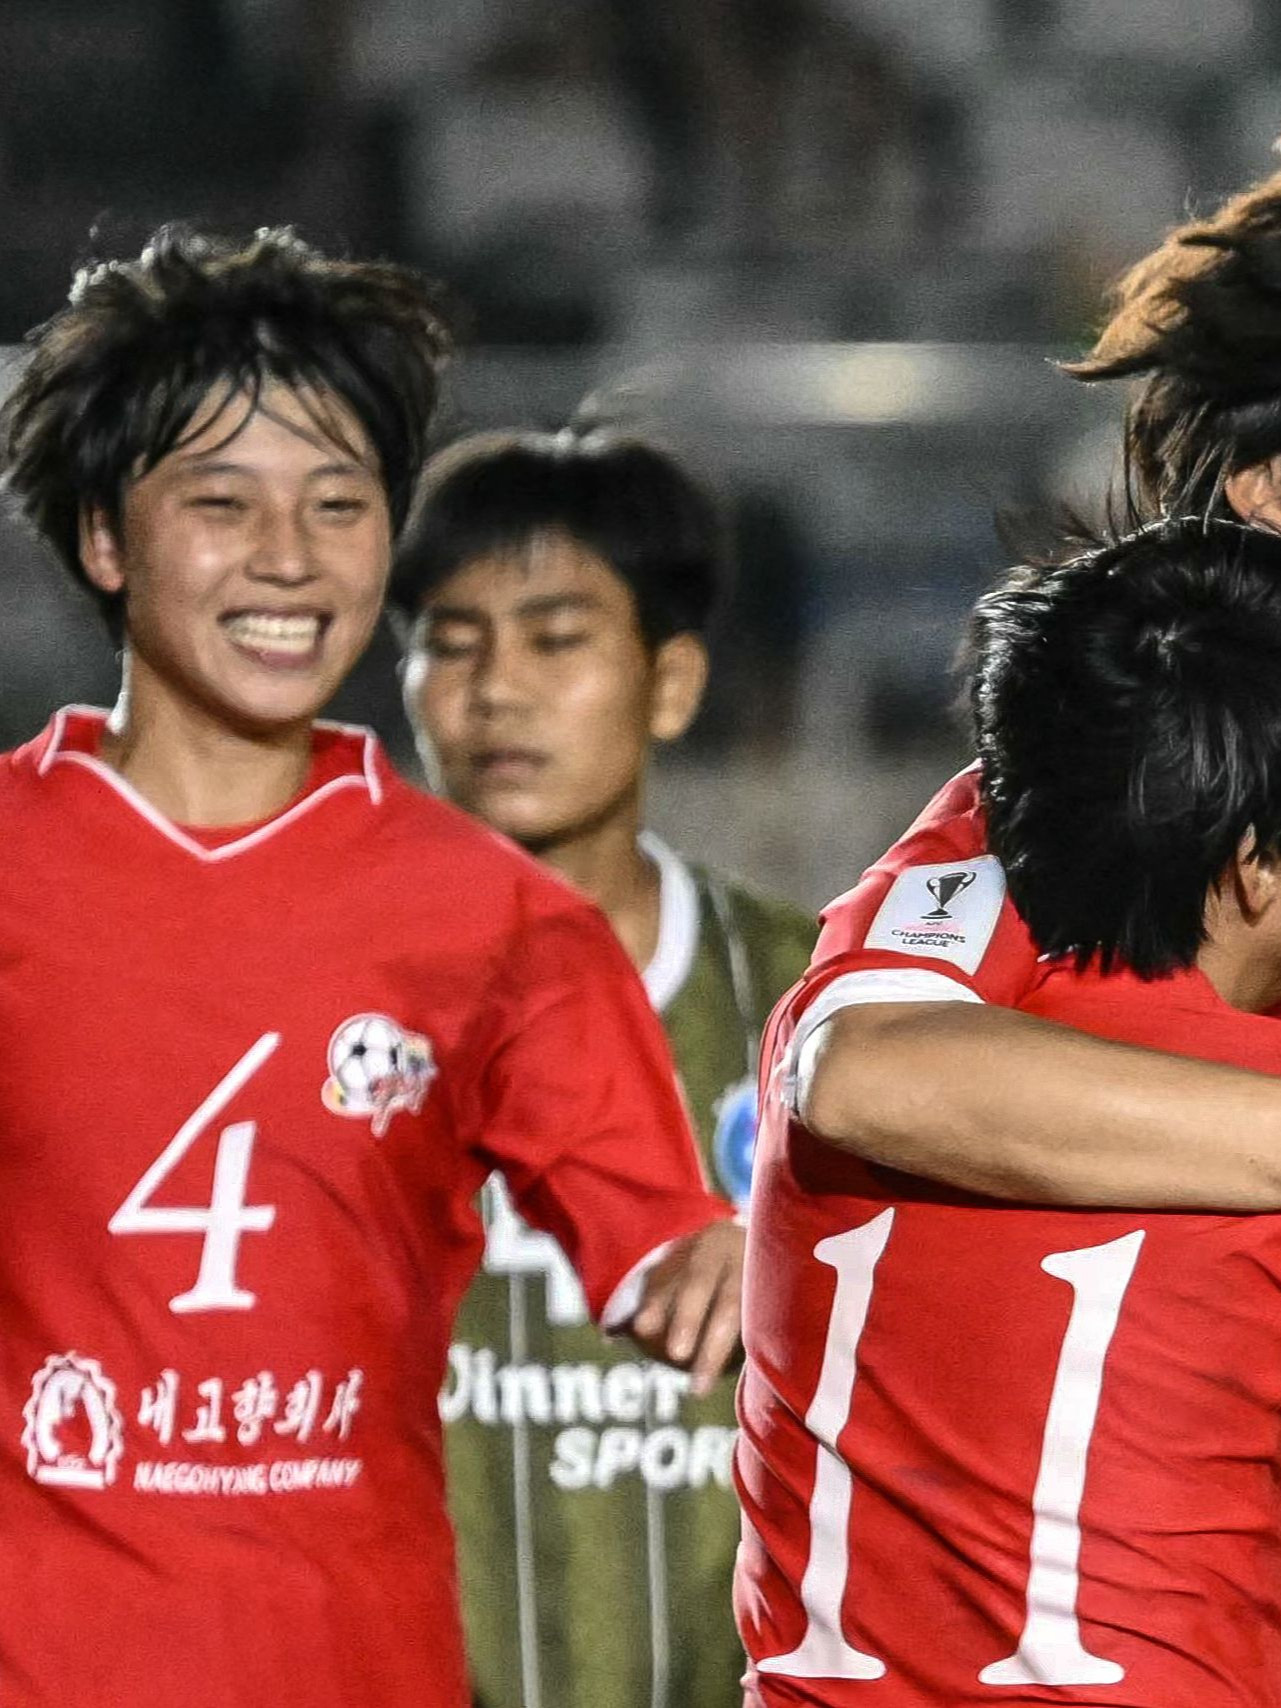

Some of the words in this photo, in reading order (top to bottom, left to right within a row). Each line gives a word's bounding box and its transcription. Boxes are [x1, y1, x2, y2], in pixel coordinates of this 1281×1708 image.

[891, 929, 966, 943] CHAMPIONS
[902, 939, 949, 947] LEAGUE
[107, 1031, 280, 1314] 4
[549, 1425, 738, 1489] SPOR
[757, 1207, 1145, 1685] 11
[268, 1457, 363, 1491] COMPANY
